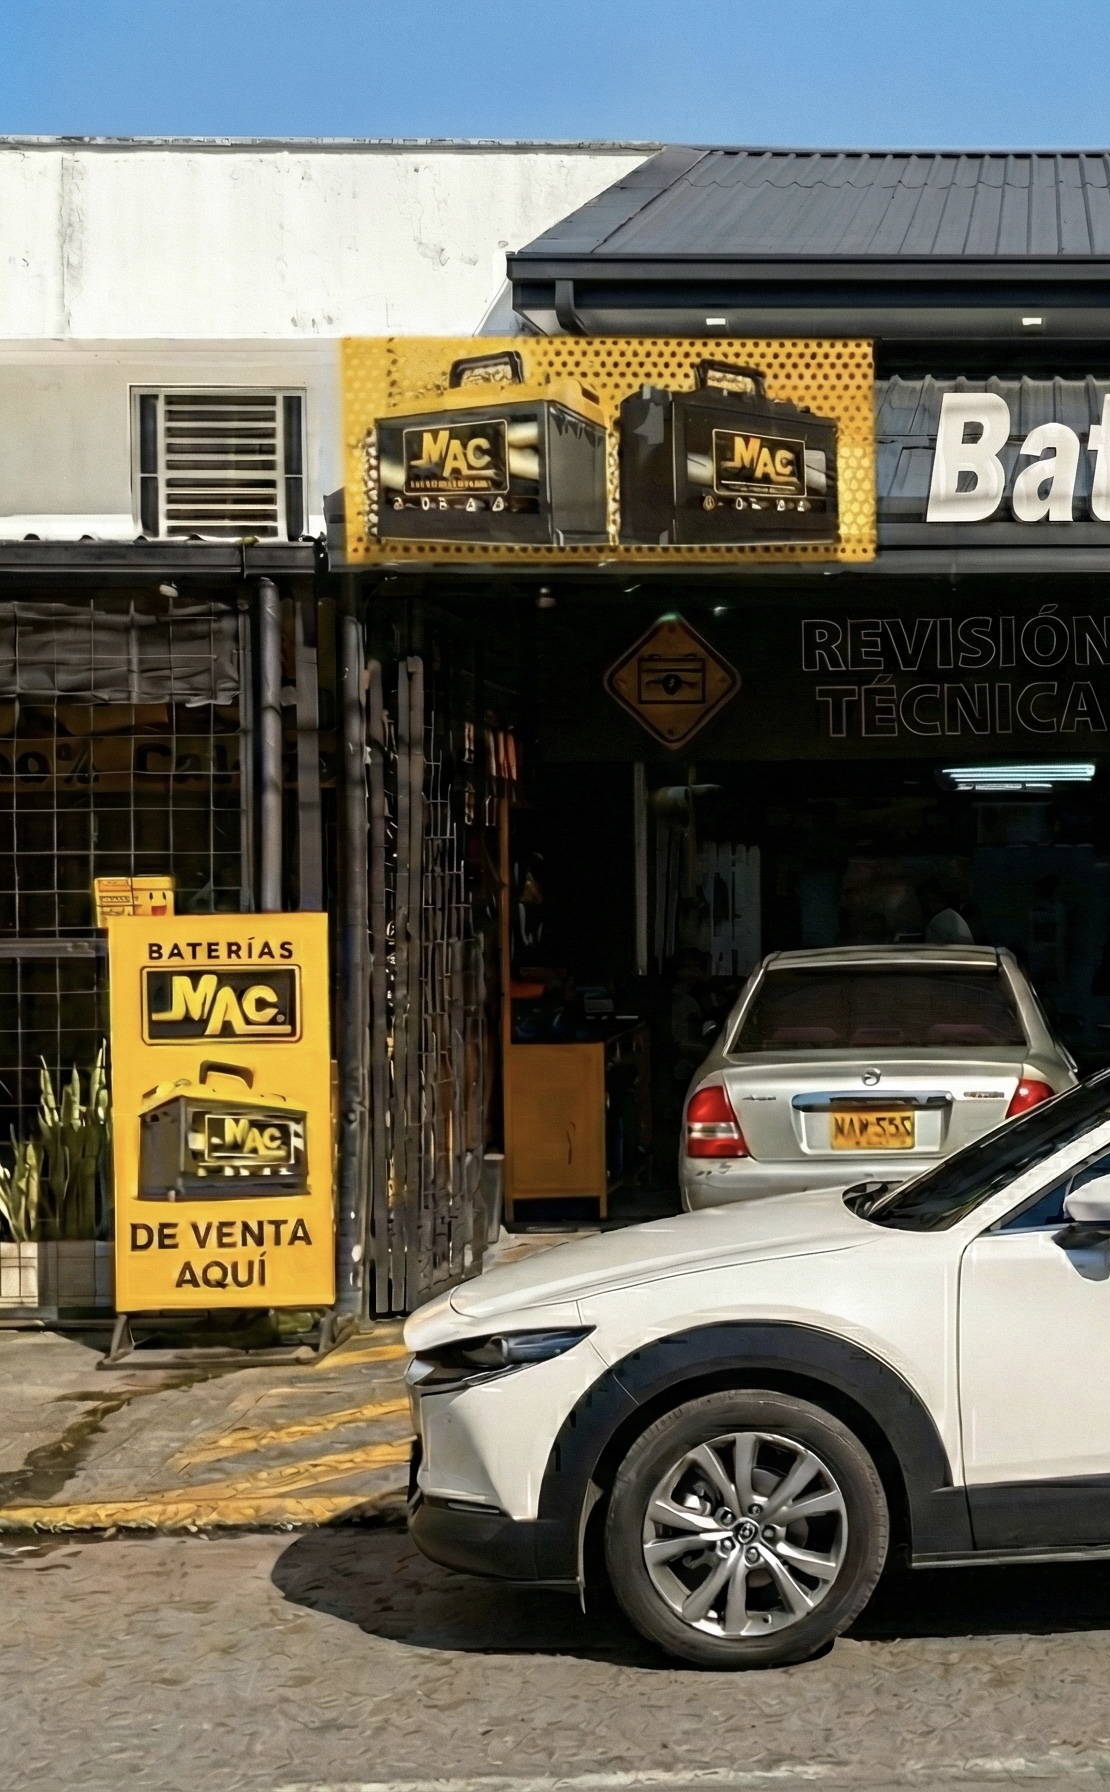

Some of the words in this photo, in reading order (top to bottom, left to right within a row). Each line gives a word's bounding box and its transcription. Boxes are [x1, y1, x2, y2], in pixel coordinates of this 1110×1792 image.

[410, 430, 497, 479] MAC
[720, 436, 799, 483] MAC
[815, 673, 1108, 738] TÉCNICA
[148, 936, 294, 960] BATERÍAS
[224, 1117, 287, 1156] MAC
[130, 1222, 179, 1252] DE
[191, 1218, 312, 1249] VENTA
[175, 1251, 267, 1288] AQUÍ
